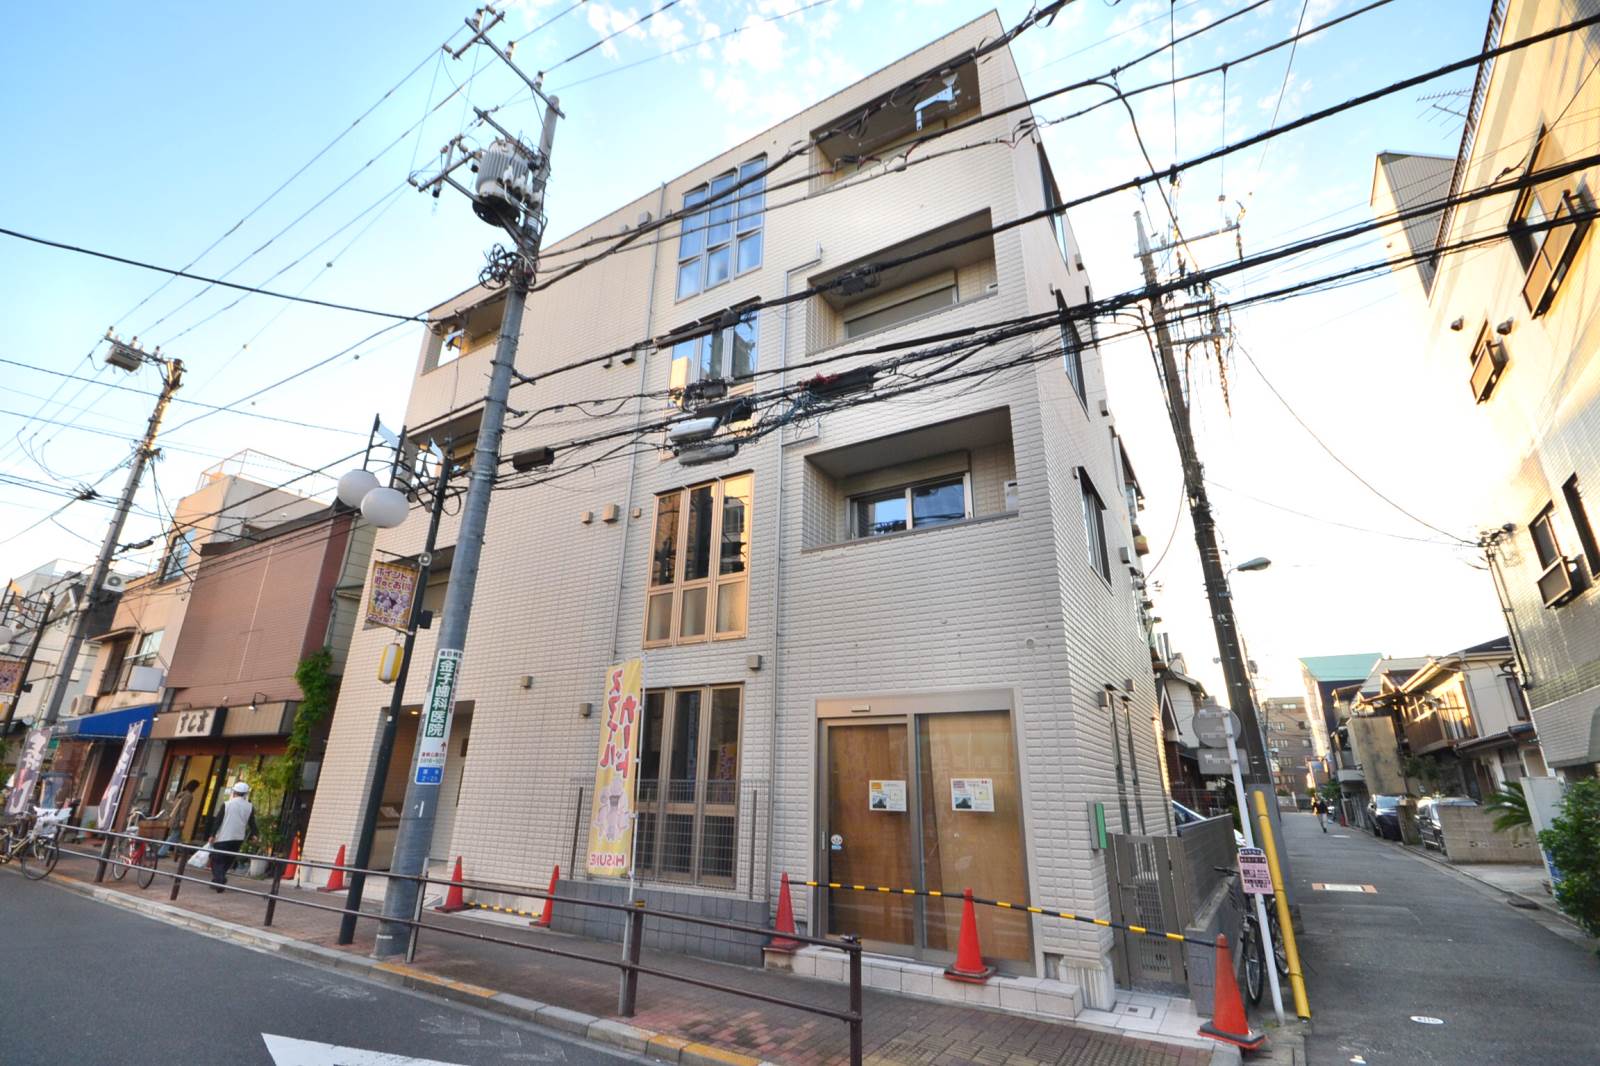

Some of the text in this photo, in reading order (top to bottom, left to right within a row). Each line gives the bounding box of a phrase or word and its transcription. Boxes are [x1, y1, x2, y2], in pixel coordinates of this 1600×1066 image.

[427, 659, 455, 736] 金子歯科医院
